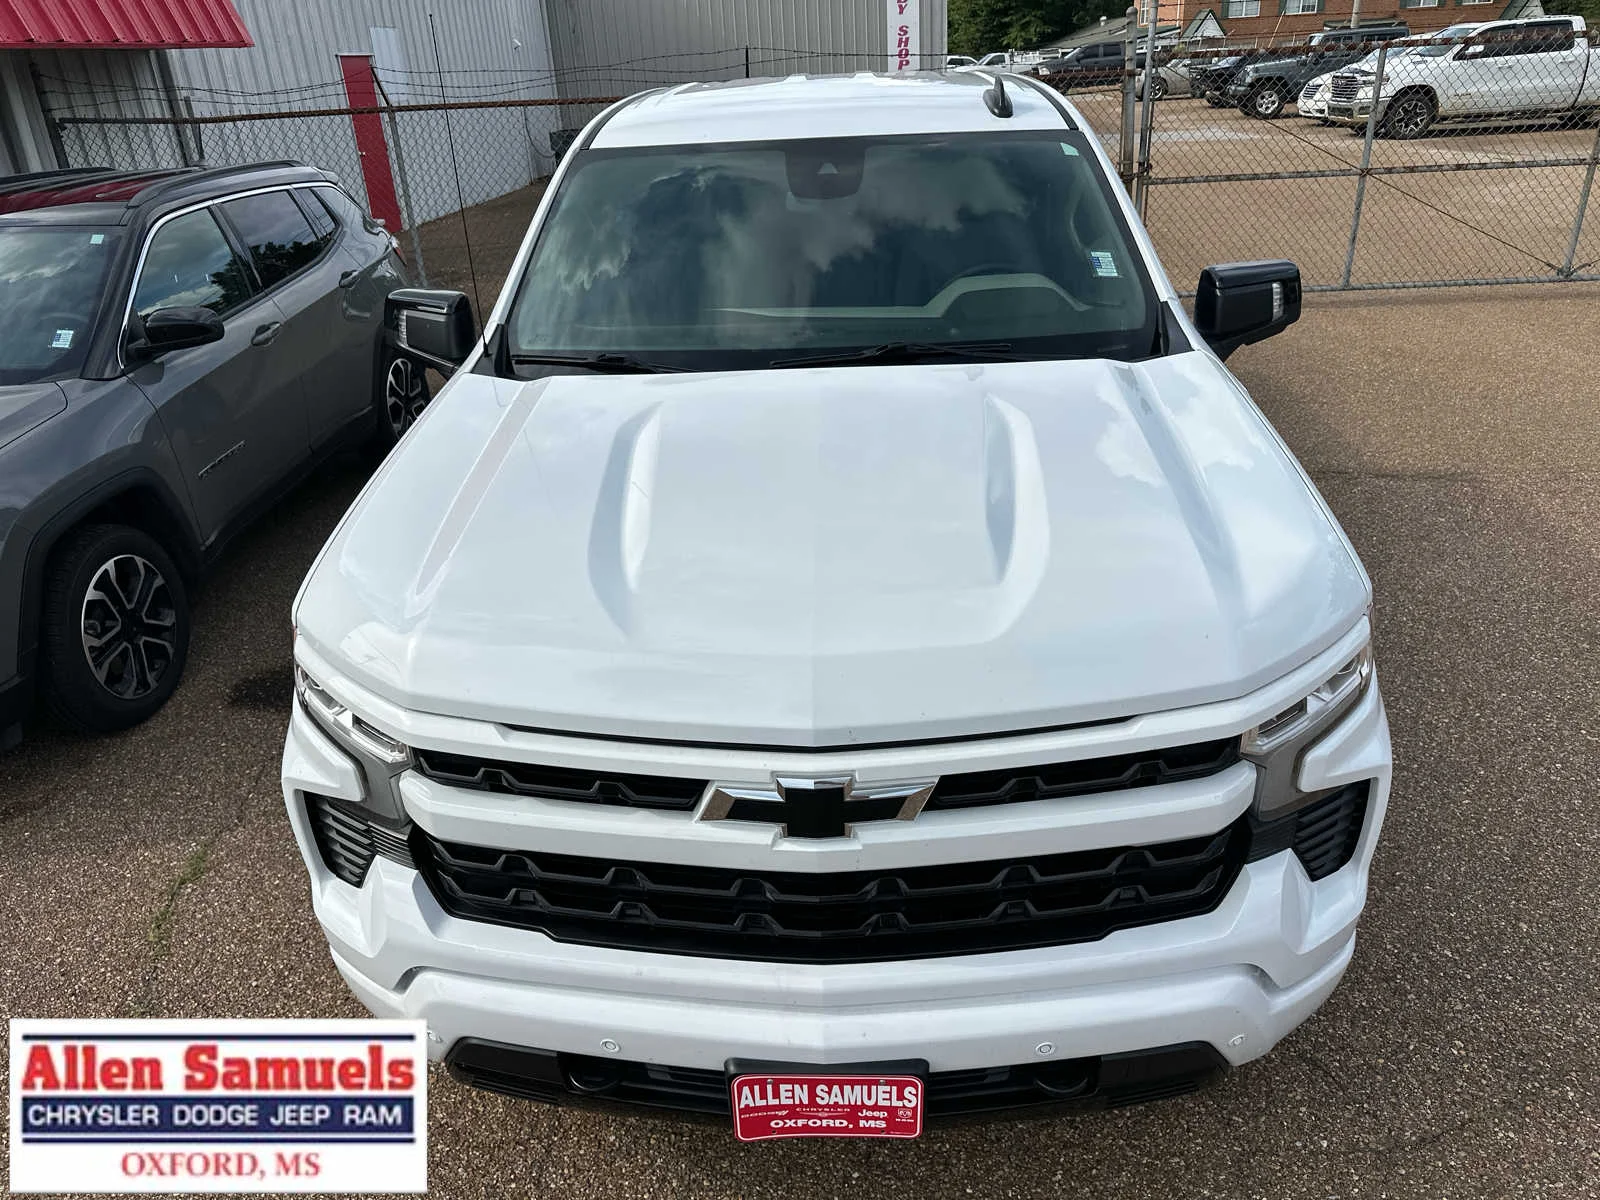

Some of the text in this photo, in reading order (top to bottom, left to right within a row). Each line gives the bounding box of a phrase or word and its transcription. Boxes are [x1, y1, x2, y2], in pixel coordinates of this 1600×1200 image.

[897, 25, 910, 71] SHOP
[739, 1083, 918, 1109] ALLEN SAMUELS
[858, 1108, 888, 1119] Jeep
[770, 1119, 854, 1129] OXFORD,
[859, 1119, 887, 1128] MS
